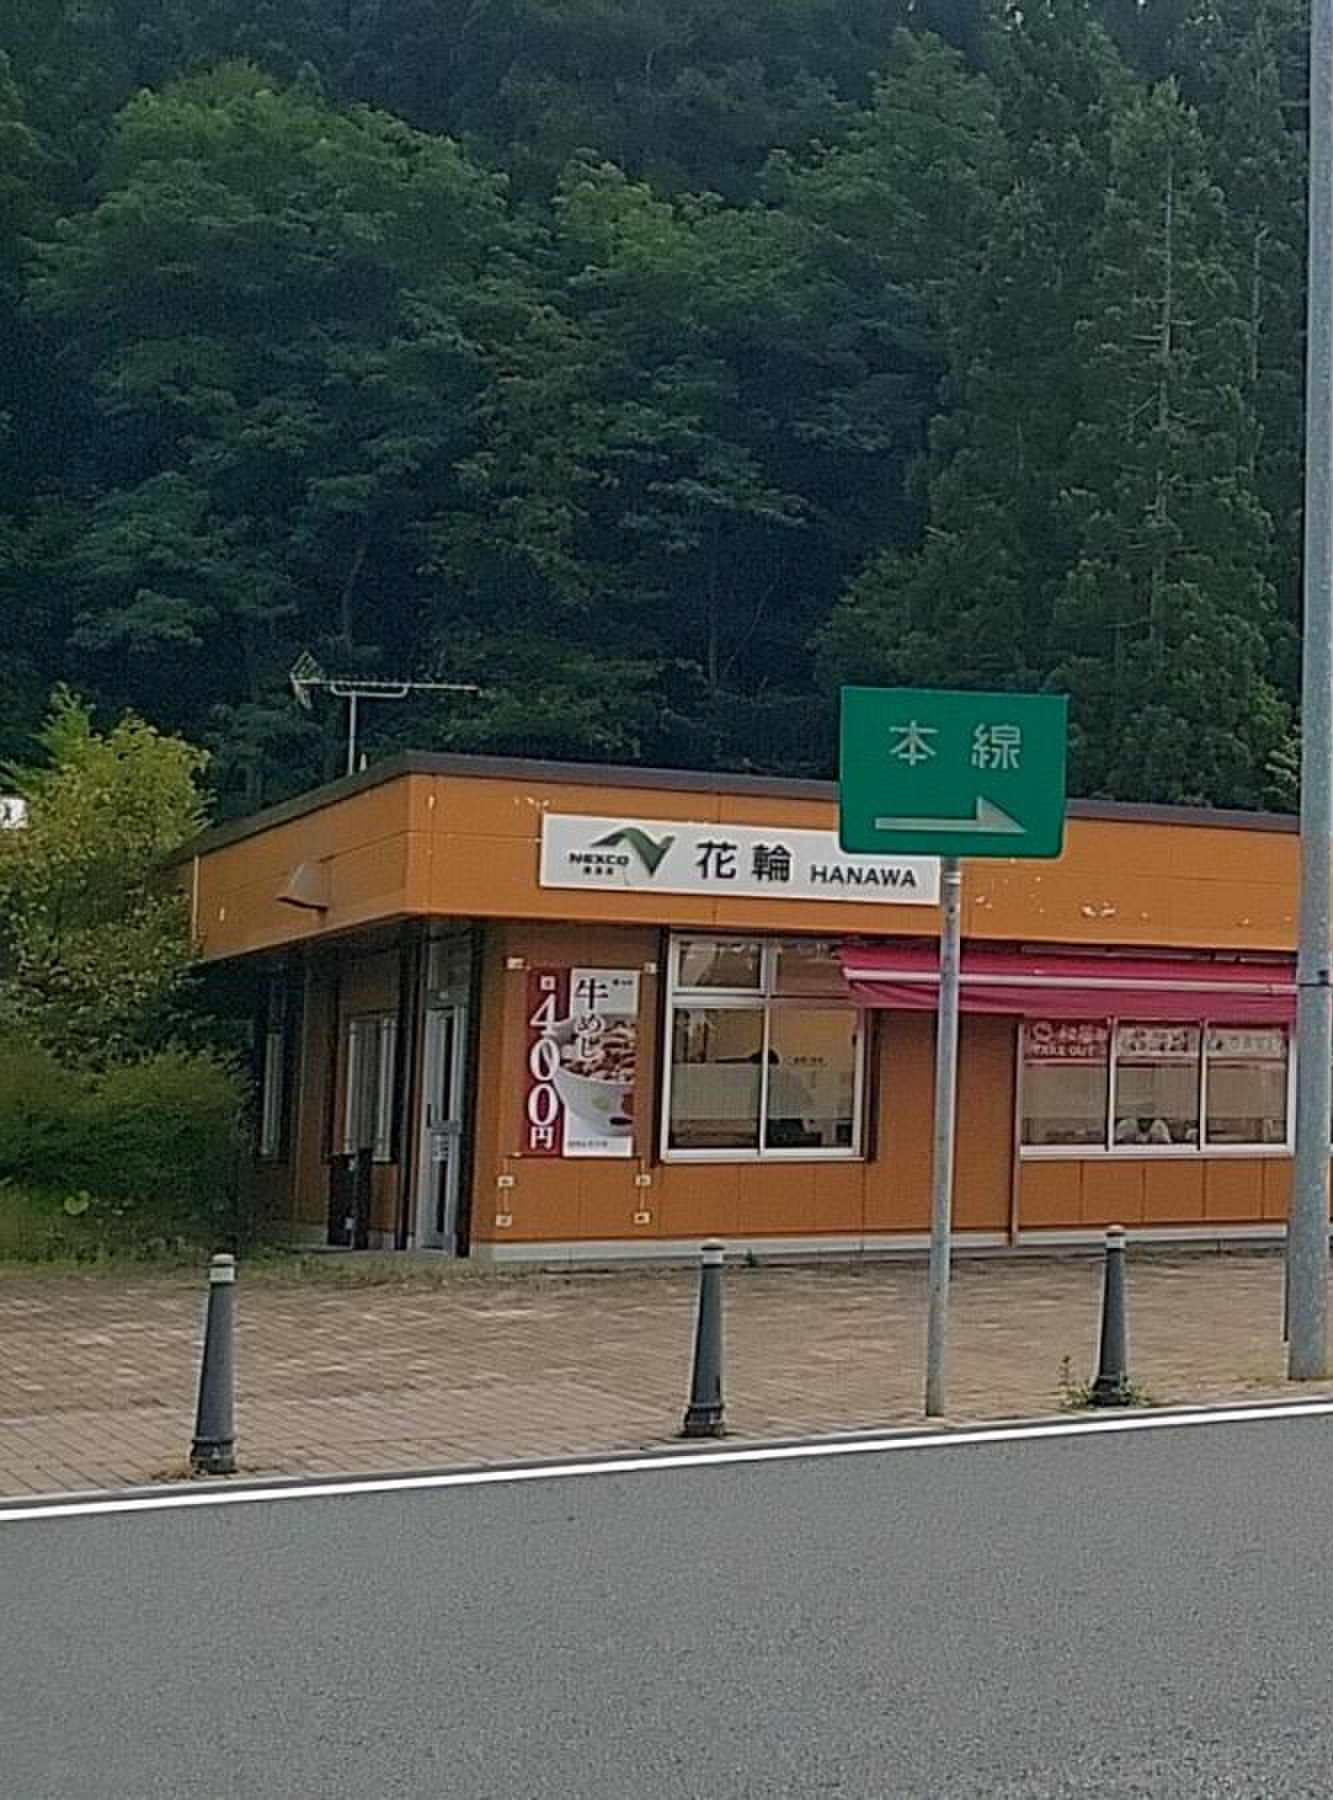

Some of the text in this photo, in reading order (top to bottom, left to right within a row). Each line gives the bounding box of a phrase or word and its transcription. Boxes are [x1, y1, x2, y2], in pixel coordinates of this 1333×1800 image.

[888, 719, 1022, 770] 本線
[569, 852, 630, 866] NEXCO
[696, 839, 793, 883] 花輪
[809, 863, 917, 889] HANAWA
